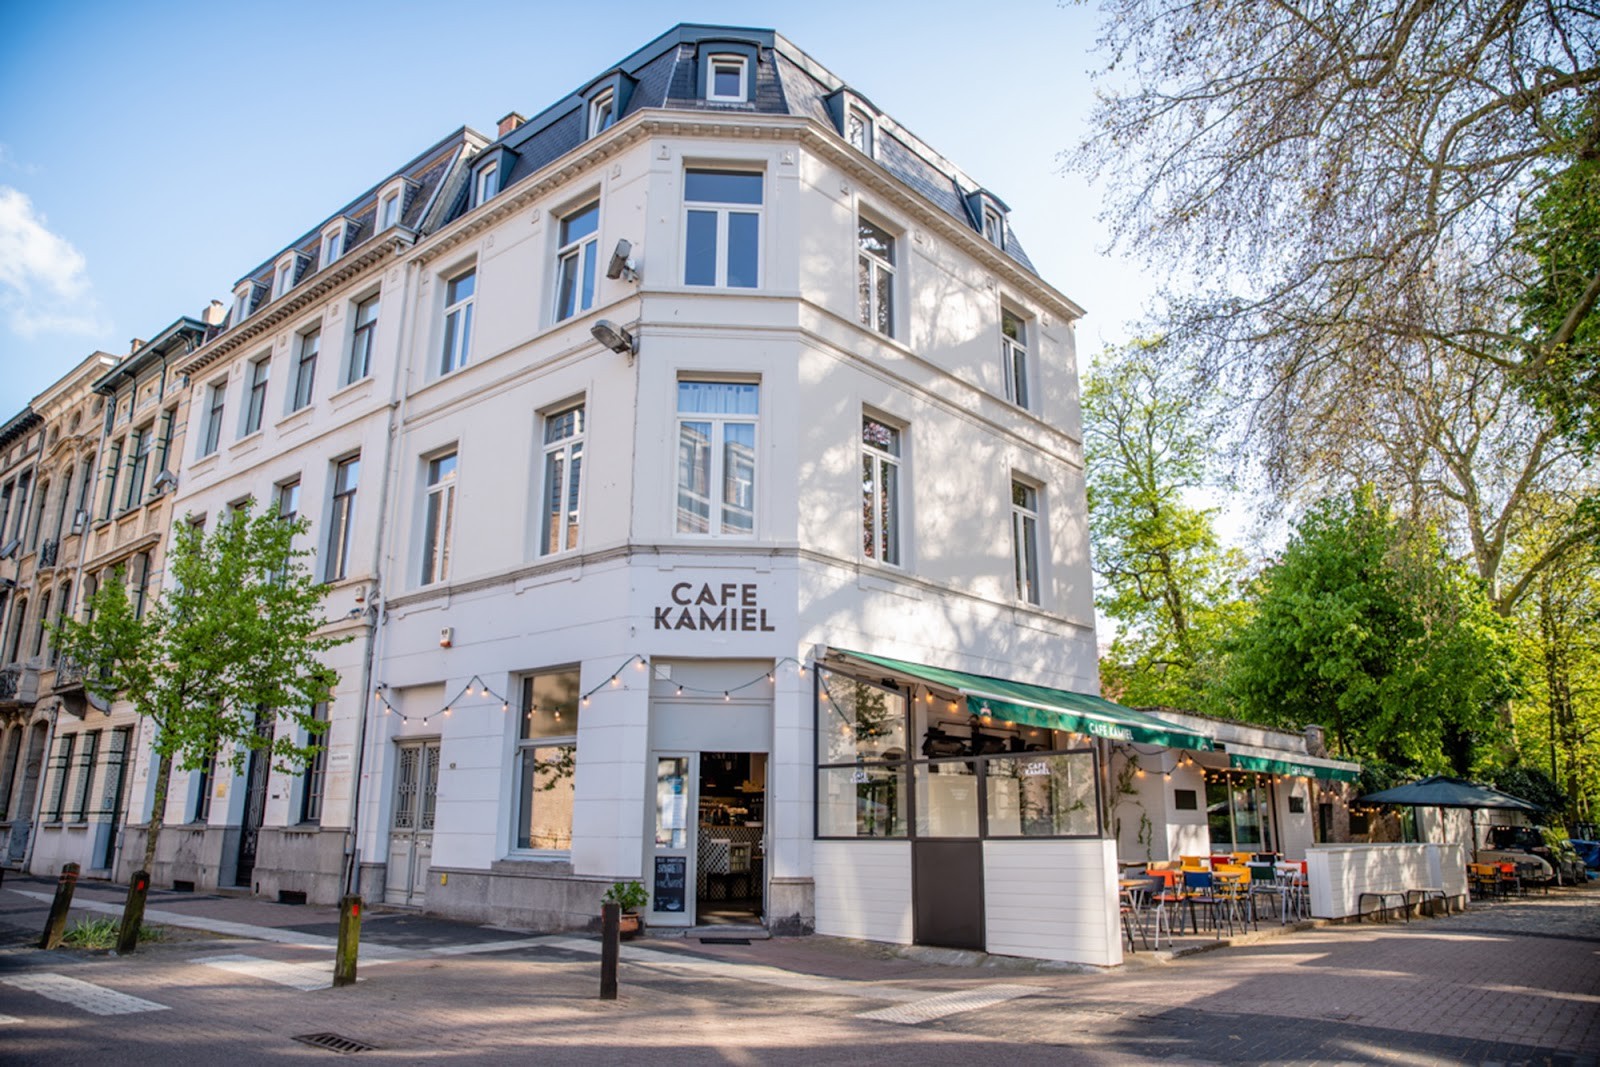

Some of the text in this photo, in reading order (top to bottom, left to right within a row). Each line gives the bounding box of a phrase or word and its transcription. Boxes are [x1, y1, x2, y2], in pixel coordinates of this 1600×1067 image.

[671, 582, 757, 606] CAFE
[654, 607, 775, 631] KAMIEL
[1088, 722, 1134, 740] CAFE KAMIEL
